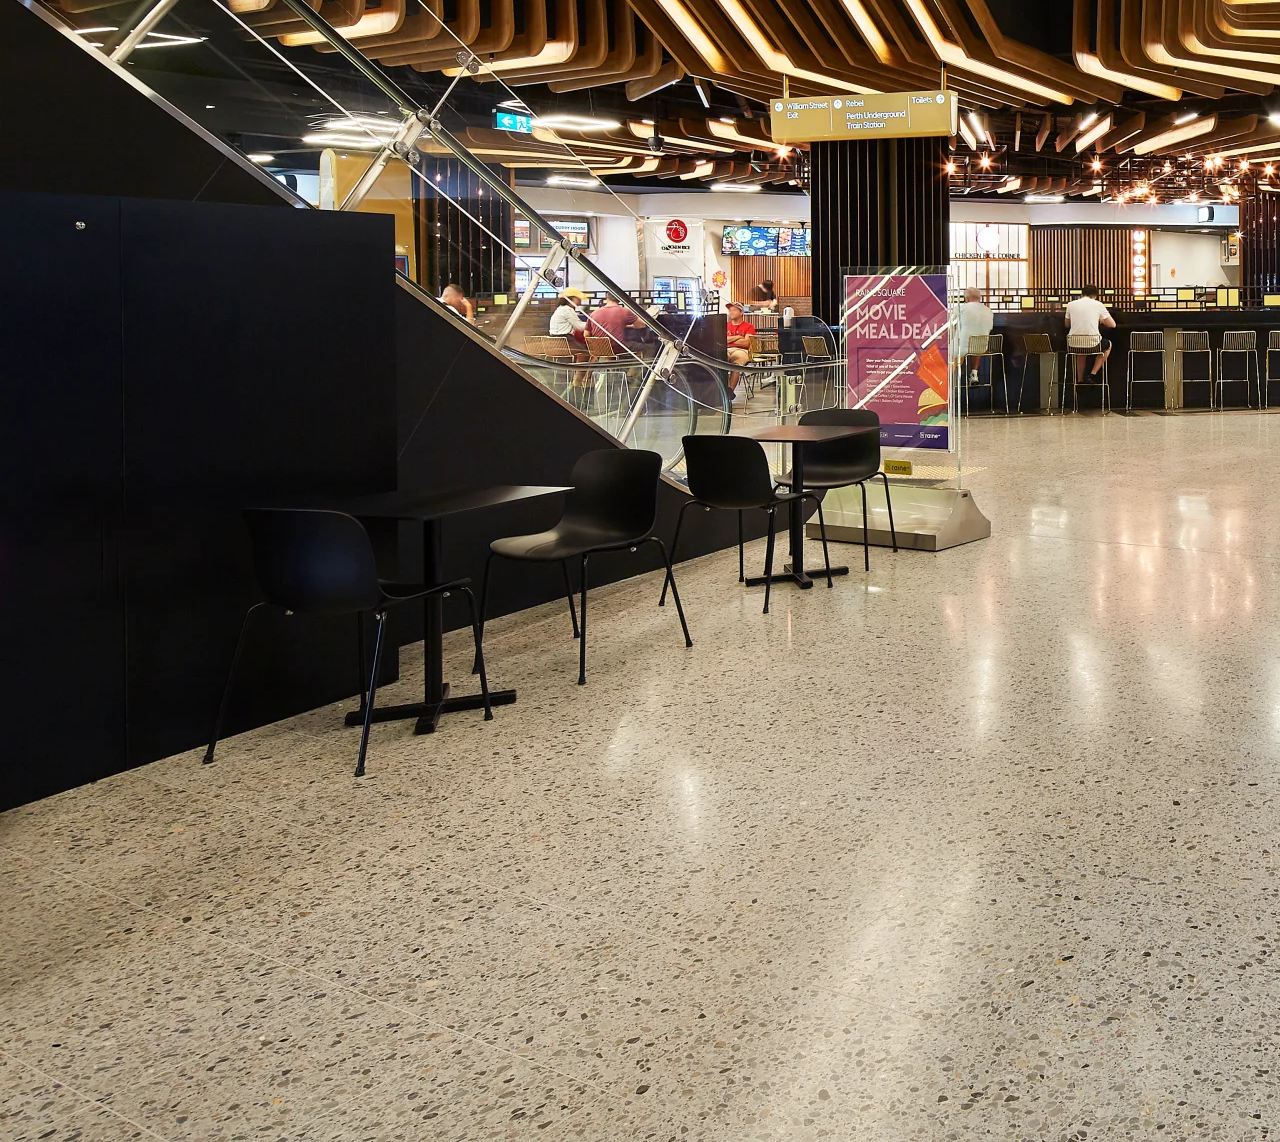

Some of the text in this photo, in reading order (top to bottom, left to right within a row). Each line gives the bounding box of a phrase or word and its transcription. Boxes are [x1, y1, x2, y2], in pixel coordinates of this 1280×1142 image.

[846, 99, 864, 107] Rebel
[911, 96, 933, 104] Toilets
[787, 101, 828, 110] William Street
[787, 111, 799, 119] Exit
[846, 110, 906, 120] Perth Underground
[863, 121, 886, 129] Station
[877, 288, 906, 297] SQUARE
[856, 304, 907, 321] MOVIE
[856, 323, 943, 340] MEAL DEAL
